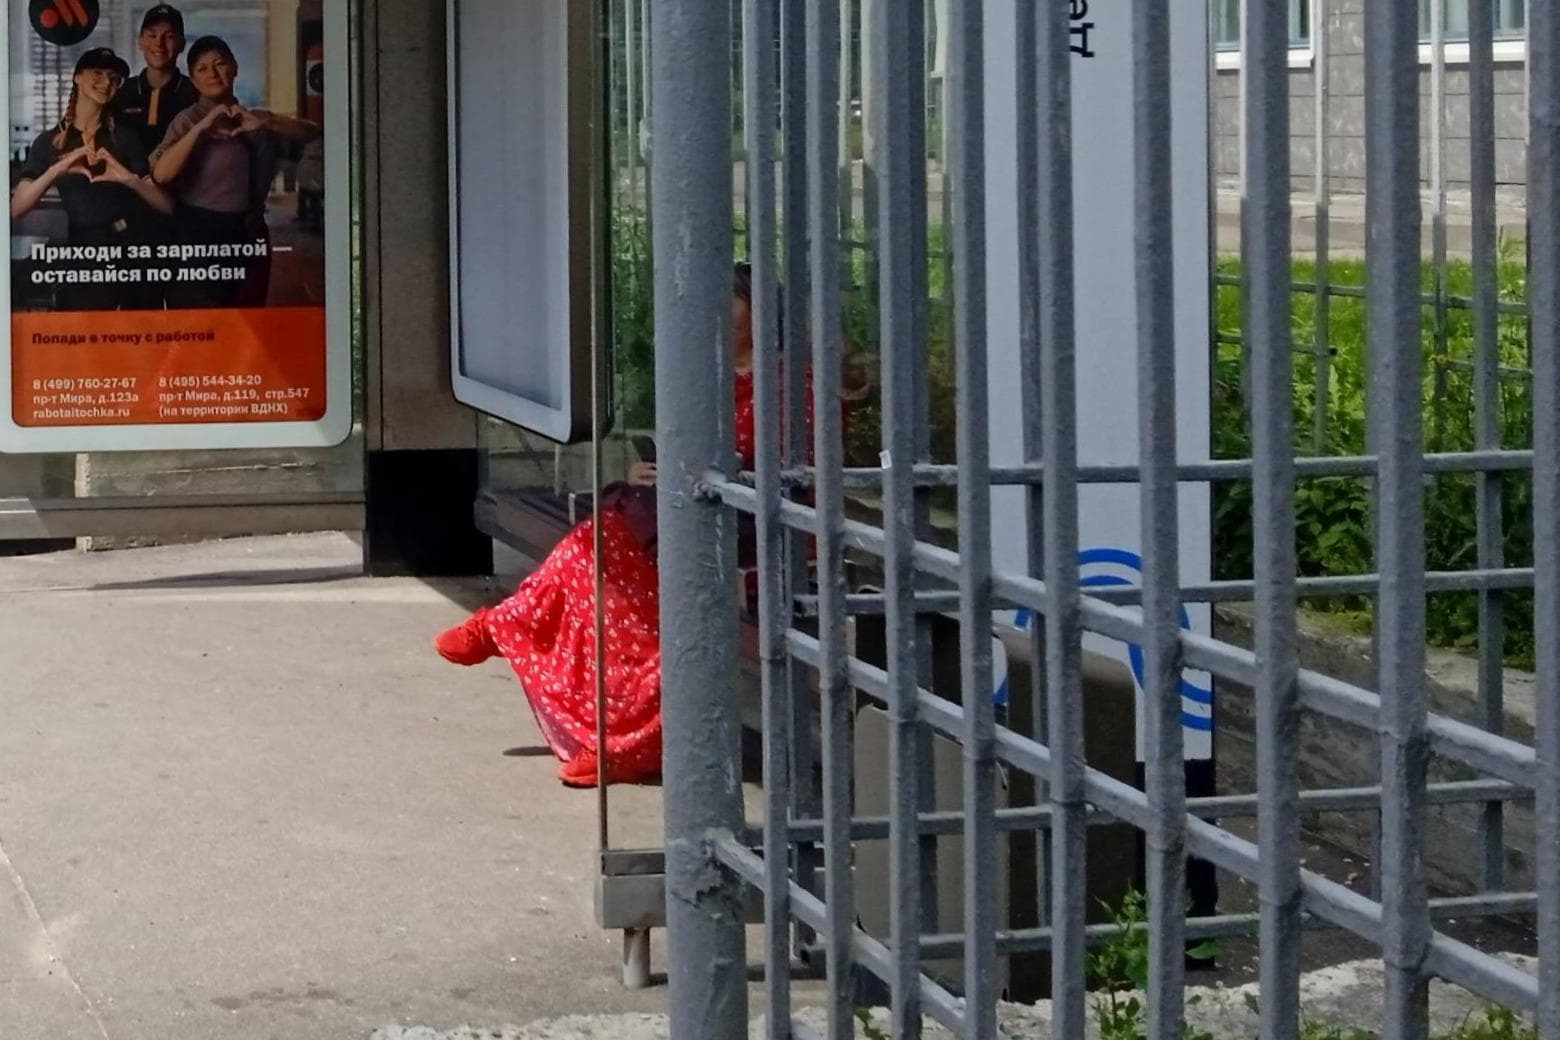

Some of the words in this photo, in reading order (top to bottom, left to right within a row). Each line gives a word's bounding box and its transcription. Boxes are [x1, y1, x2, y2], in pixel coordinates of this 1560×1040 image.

[31, 243, 122, 263] Приходи
[127, 244, 151, 259] за
[156, 239, 267, 261] зарплатой
[31, 265, 141, 284] оставайся
[146, 268, 172, 282] по
[176, 264, 246, 281] любви
[32, 333, 86, 345] Попади
[90, 335, 98, 344] в
[102, 333, 141, 346] точку
[144, 333, 153, 343] с
[156, 330, 215, 345] работой
[33, 378, 41, 390] 8
[43, 378, 75, 391] (499)
[78, 377, 137, 389] 760-27-67
[158, 376, 167, 387] 8
[169, 376, 200, 388] (495)
[202, 374, 262, 386] 544-34-20
[33, 394, 57, 405] пр-т
[59, 393, 96, 405] Мира,
[98, 391, 139, 404] д.123а
[159, 392, 183, 403] пр-т
[185, 390, 220, 402] Мира,
[265, 387, 309, 400] стр.547
[33, 407, 130, 419] rabotaitochka.ru
[159, 405, 178, 418] (на
[180, 405, 249, 417] территории
[251, 402, 288, 414] ВДНХ)
